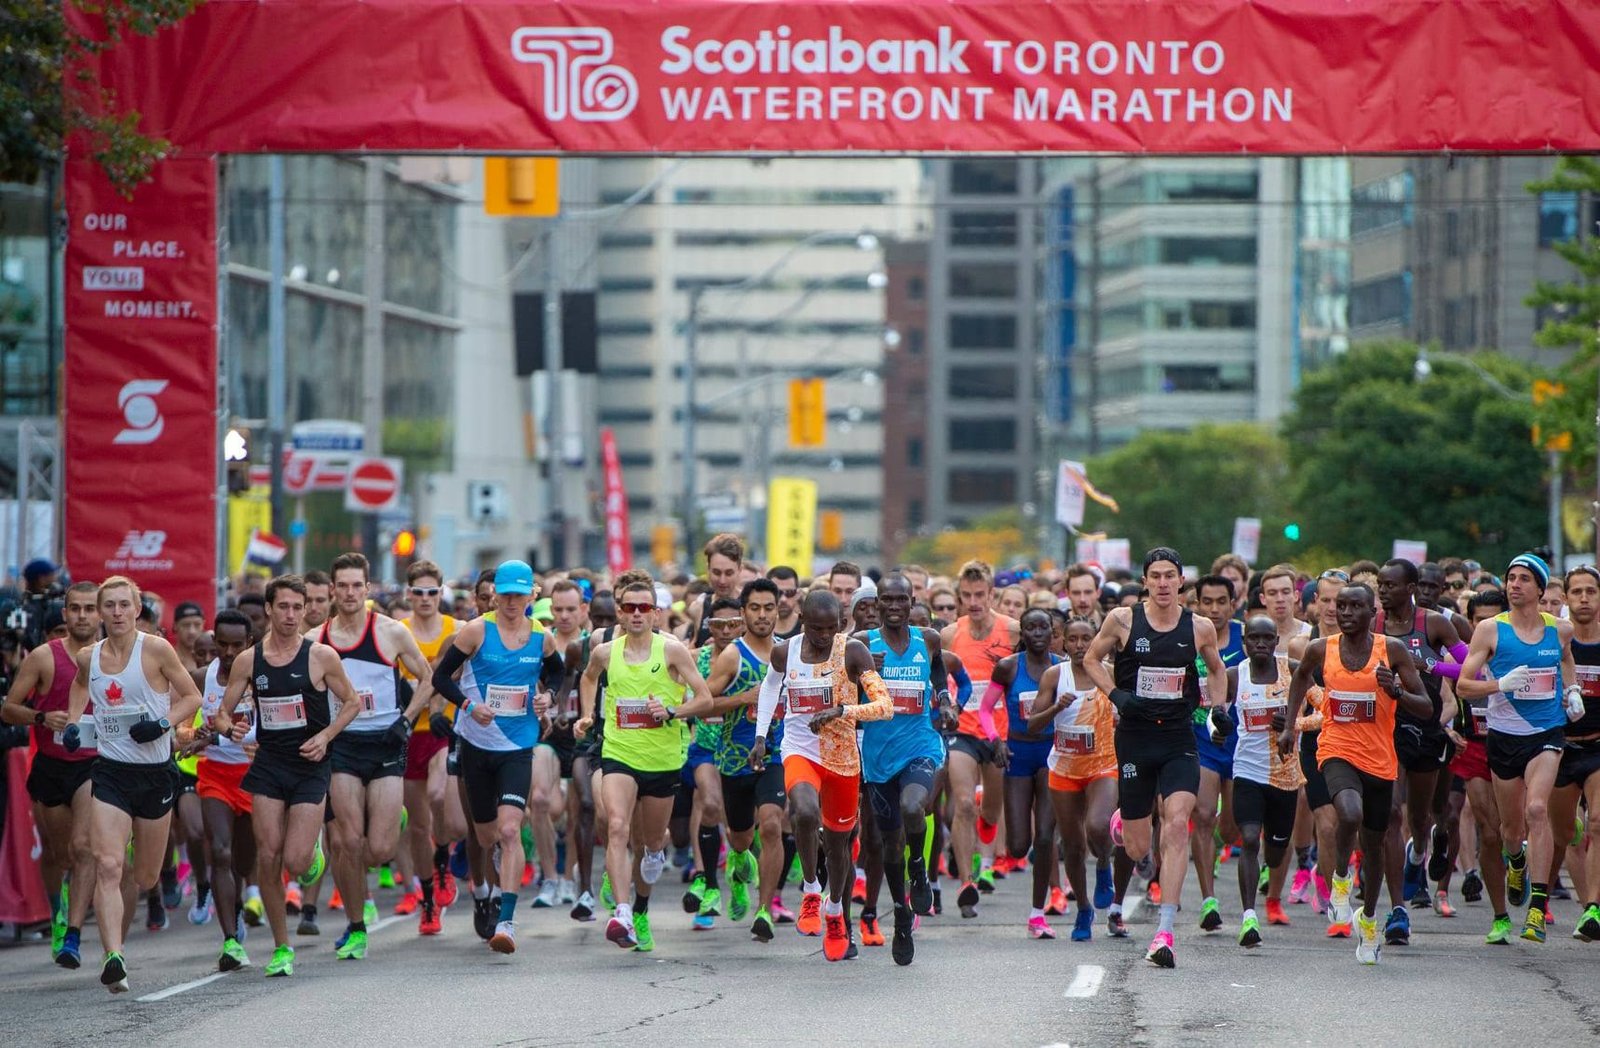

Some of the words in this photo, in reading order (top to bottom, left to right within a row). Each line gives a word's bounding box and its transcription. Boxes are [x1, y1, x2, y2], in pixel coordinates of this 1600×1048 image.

[659, 25, 971, 75] Scotiabank
[985, 40, 1226, 75] TORONTO
[660, 86, 994, 121] WATERFRONT
[1013, 86, 1293, 122] MARATHON
[84, 213, 127, 230] OUR
[113, 240, 185, 257] PLACE.
[86, 269, 139, 285] YOUR
[104, 300, 199, 317] MOMENT.
[104, 559, 127, 570] new
[128, 557, 174, 570] balance
[1141, 683, 1153, 691] 22
[489, 700, 501, 709] 28
[1339, 702, 1358, 715] 67
[263, 714, 273, 722] 24
[104, 724, 120, 734] 150
